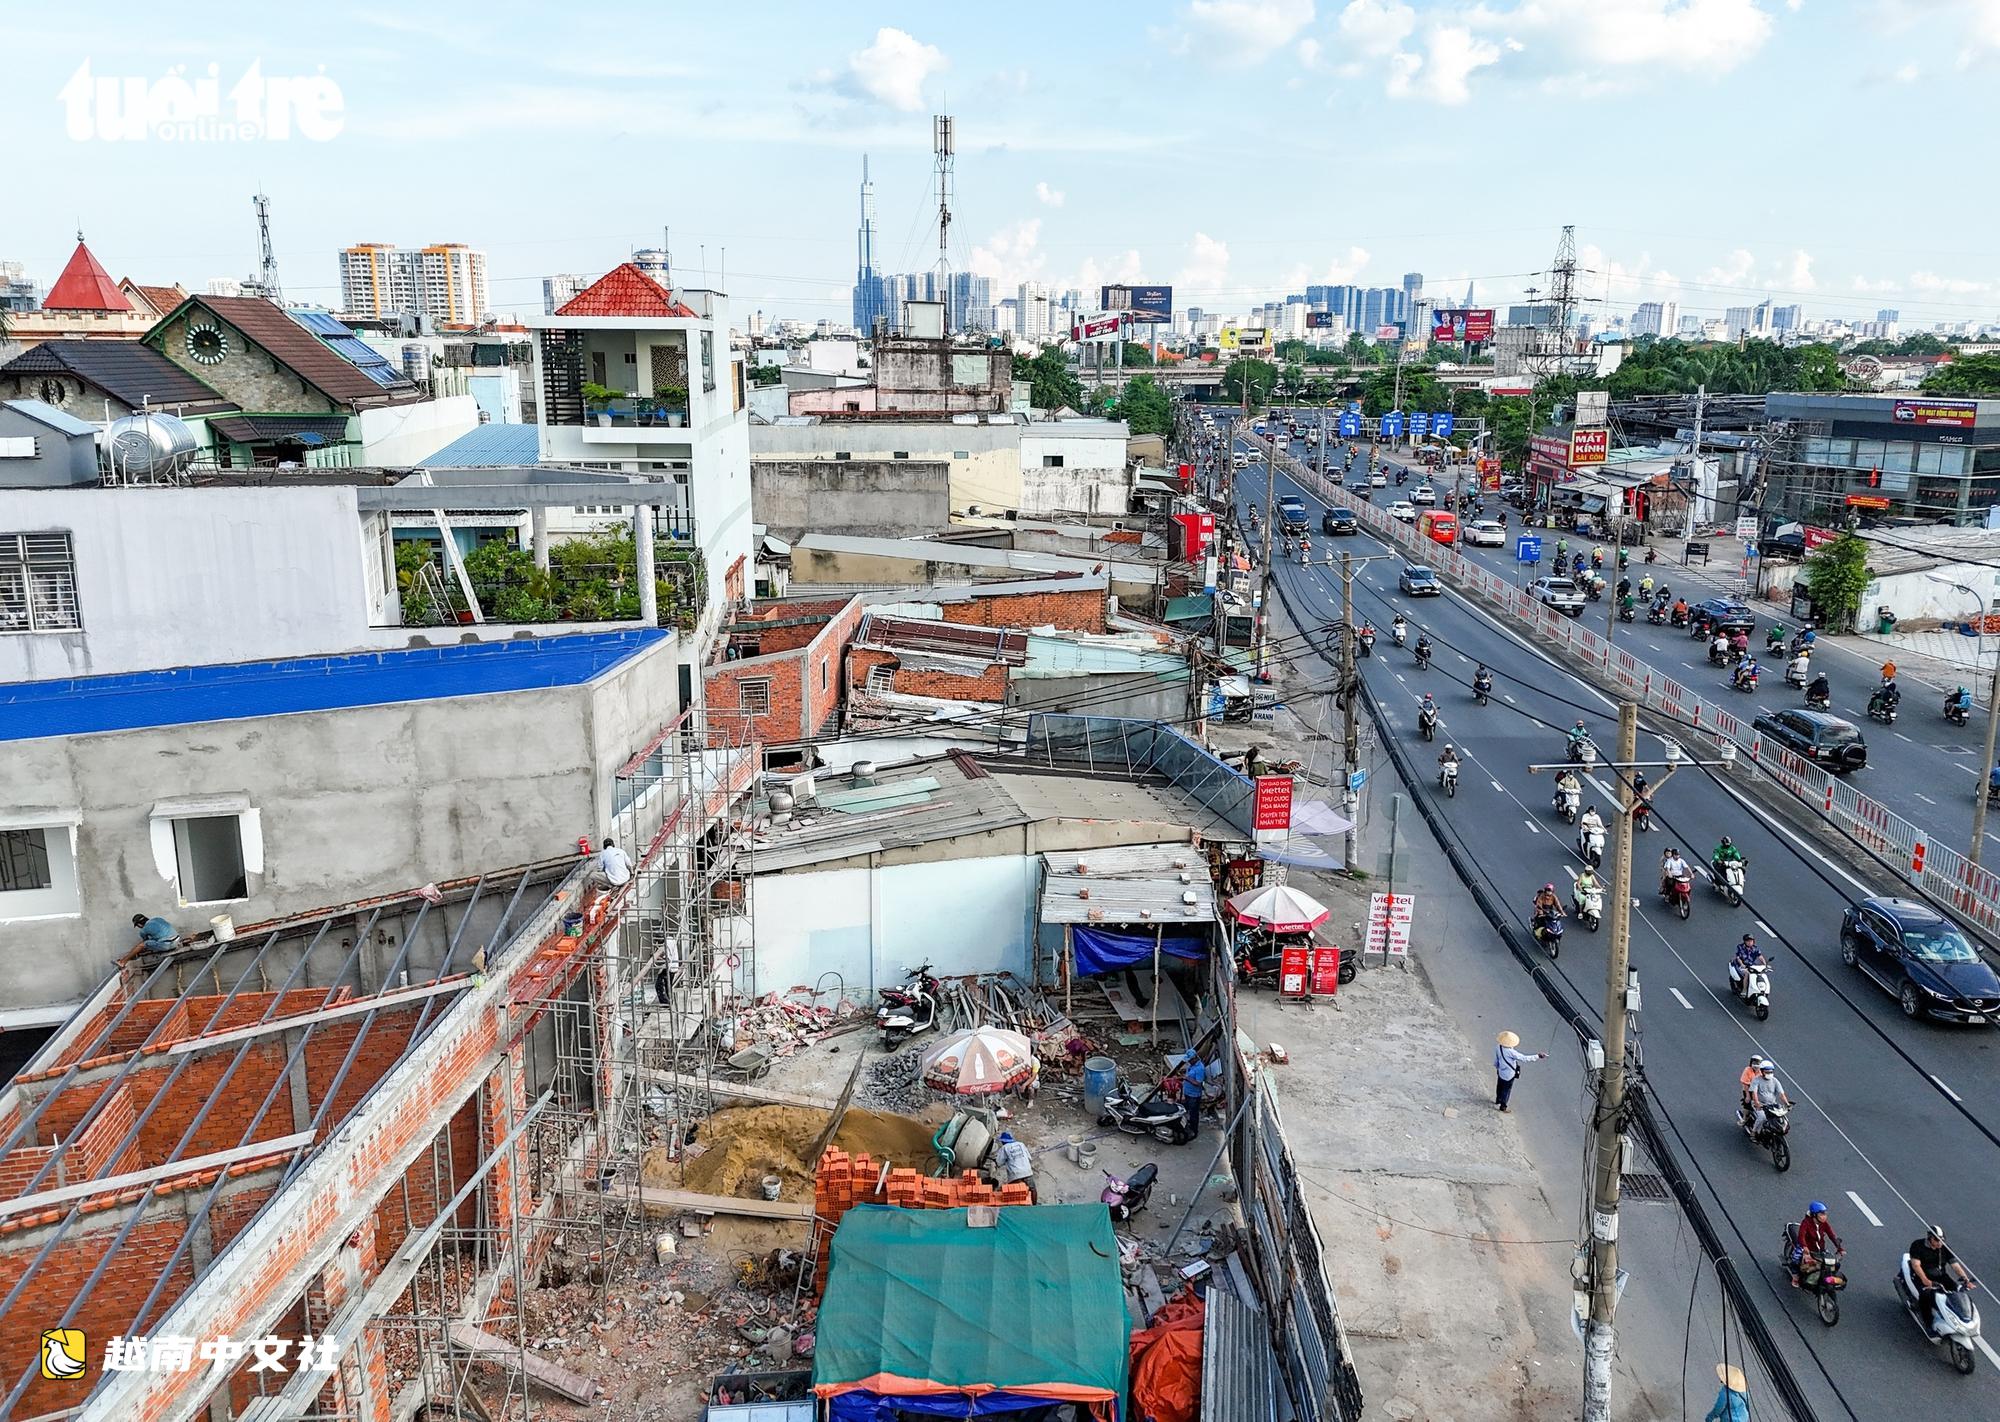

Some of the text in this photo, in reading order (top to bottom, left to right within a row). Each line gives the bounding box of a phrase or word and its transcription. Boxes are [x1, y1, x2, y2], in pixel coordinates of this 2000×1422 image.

[1575, 432, 1603, 444] MẮT
[1575, 443, 1604, 453] KÍNH
[1261, 787, 1290, 795] viettel
